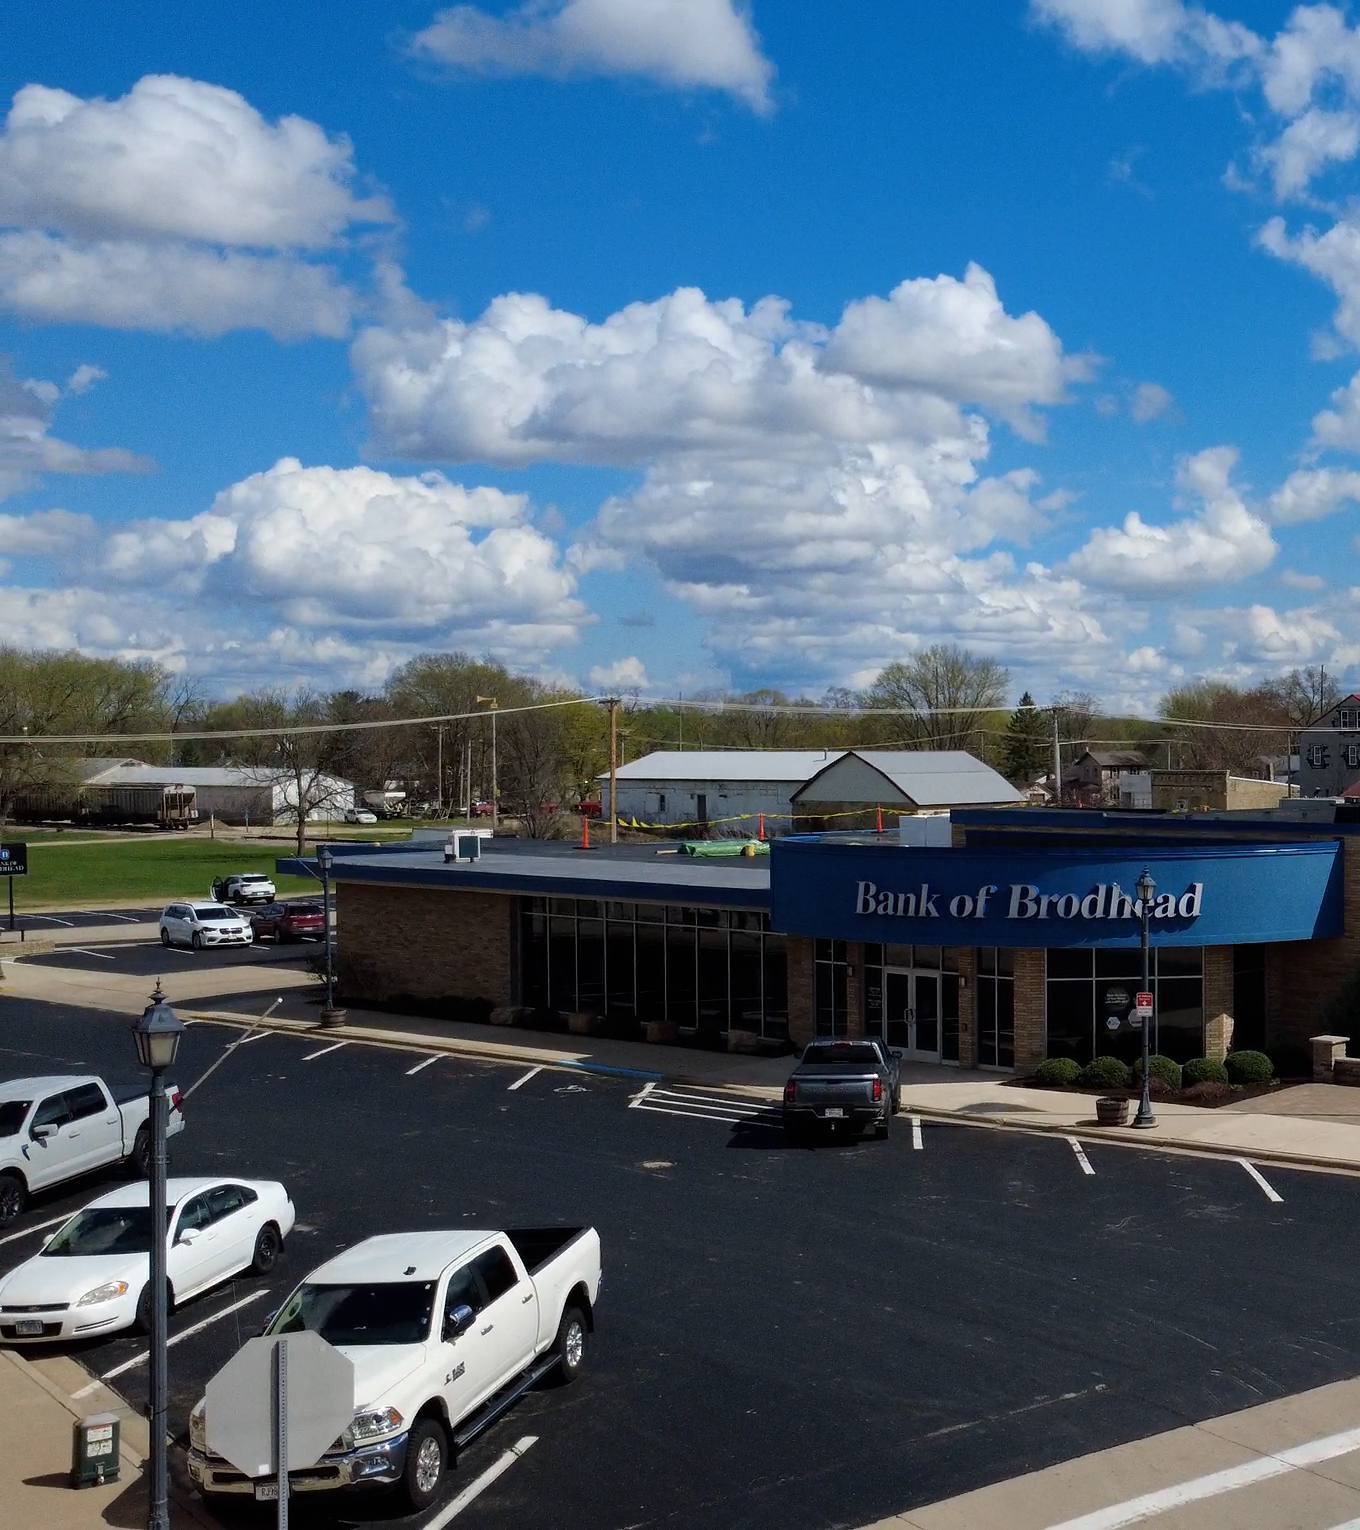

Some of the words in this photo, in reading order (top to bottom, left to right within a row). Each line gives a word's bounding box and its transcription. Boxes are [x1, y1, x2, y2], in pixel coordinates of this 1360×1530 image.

[854, 881, 940, 918] Bank
[950, 884, 998, 919] of
[1004, 882, 1204, 920] Brodhead
